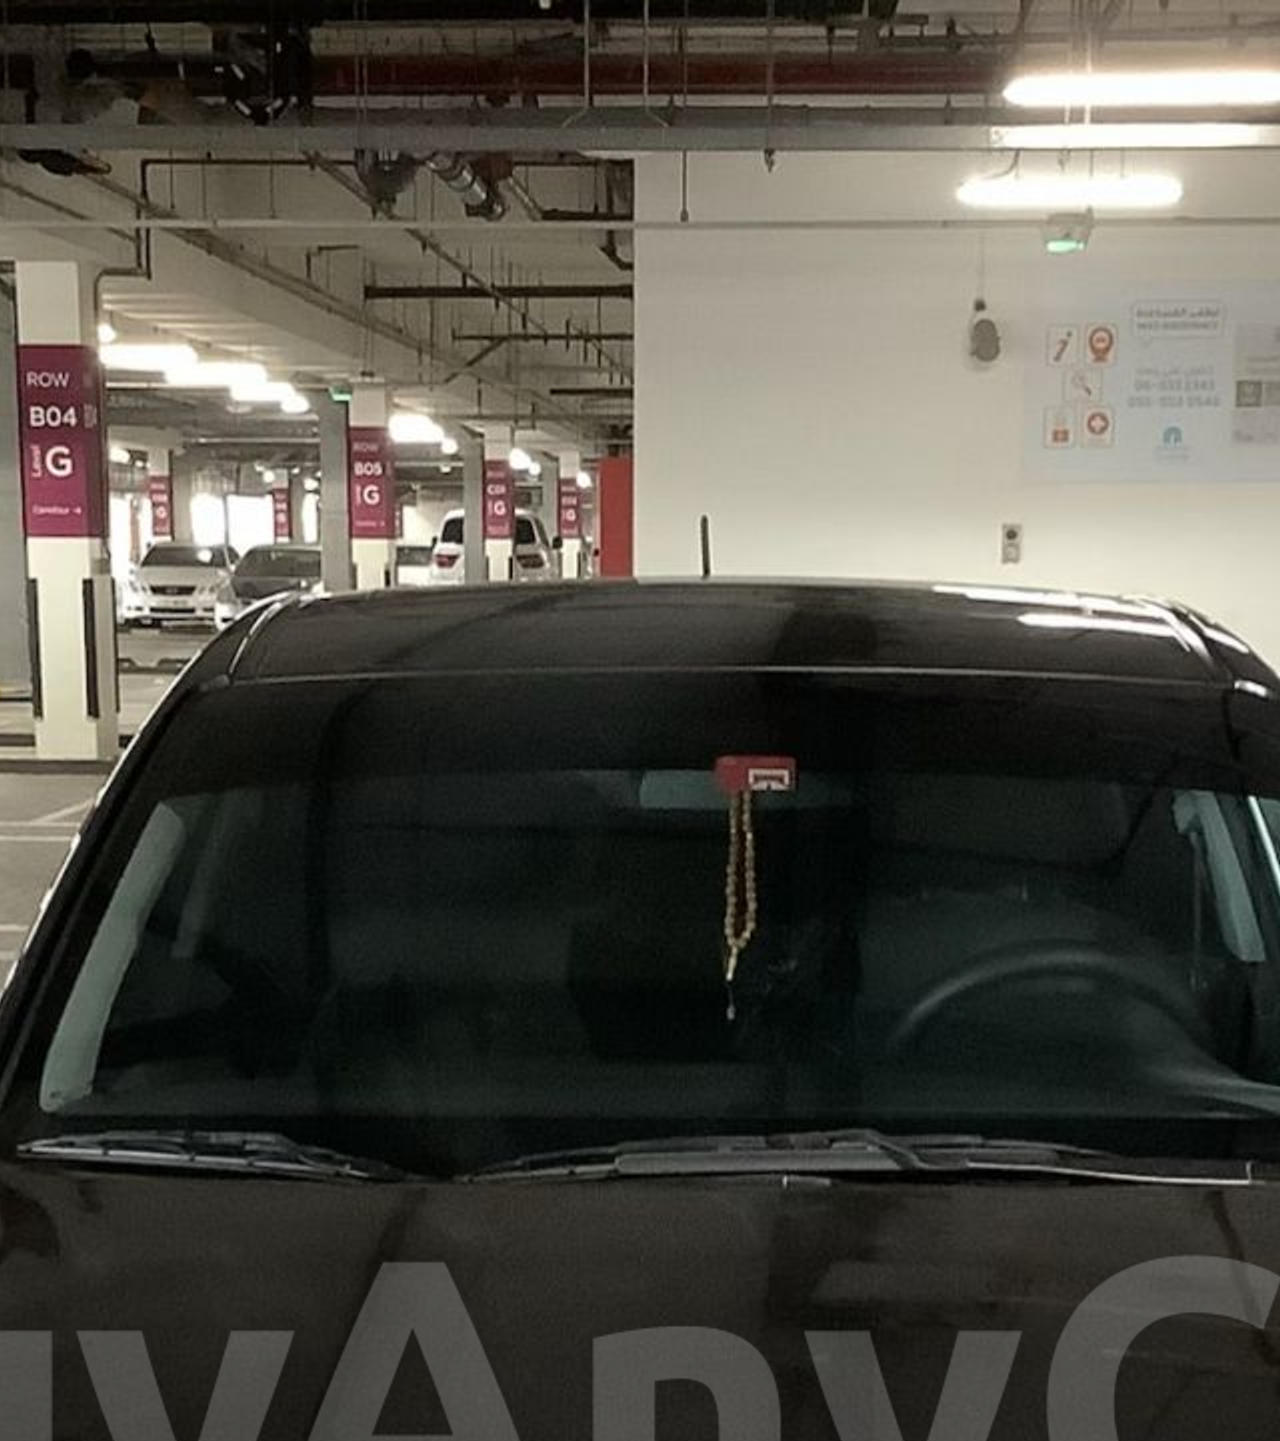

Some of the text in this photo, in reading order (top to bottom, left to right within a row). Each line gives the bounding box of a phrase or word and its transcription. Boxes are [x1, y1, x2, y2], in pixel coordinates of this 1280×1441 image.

[26, 371, 70, 388] ROW
[29, 406, 77, 428] B04
[45, 446, 74, 478] G
[363, 484, 381, 505] G
